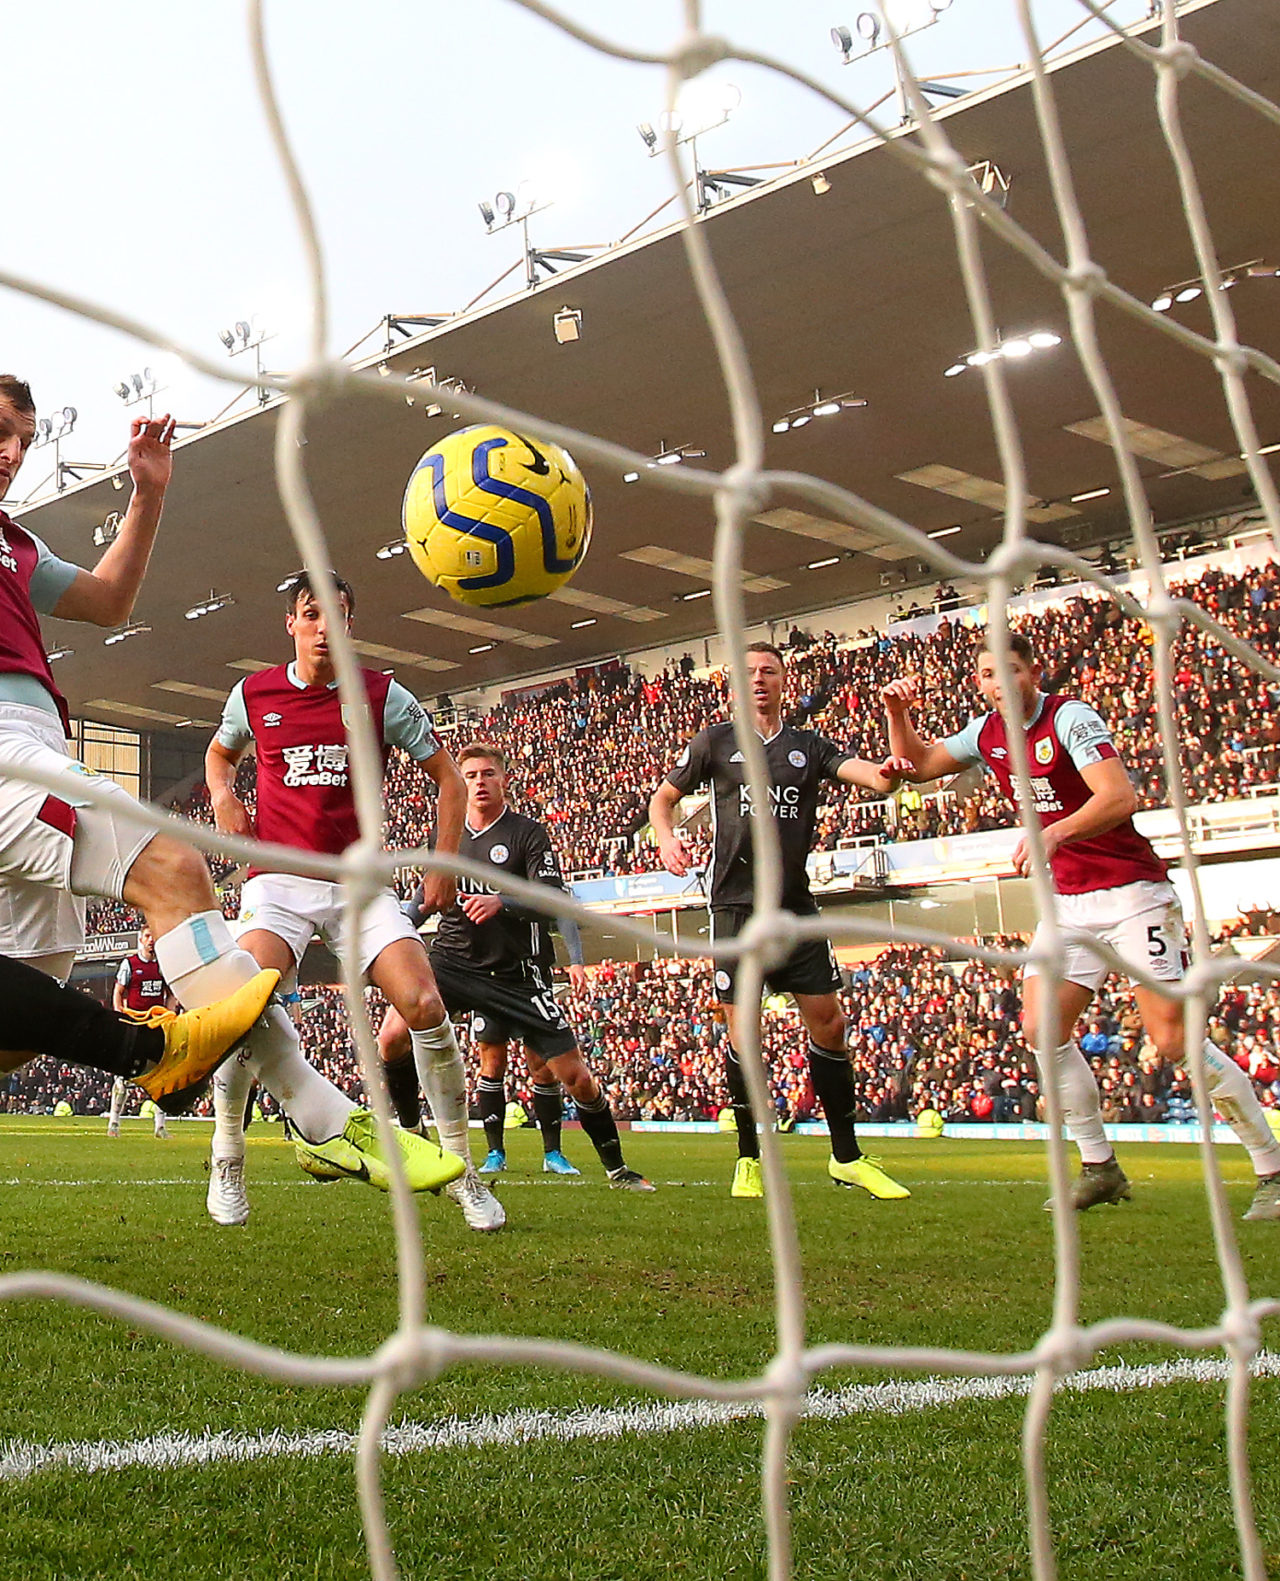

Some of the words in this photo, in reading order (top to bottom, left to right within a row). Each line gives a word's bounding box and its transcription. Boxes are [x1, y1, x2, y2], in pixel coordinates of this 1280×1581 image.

[740, 784, 800, 805] KNG
[1147, 926, 1167, 957] 5
[531, 990, 561, 1021] 15
